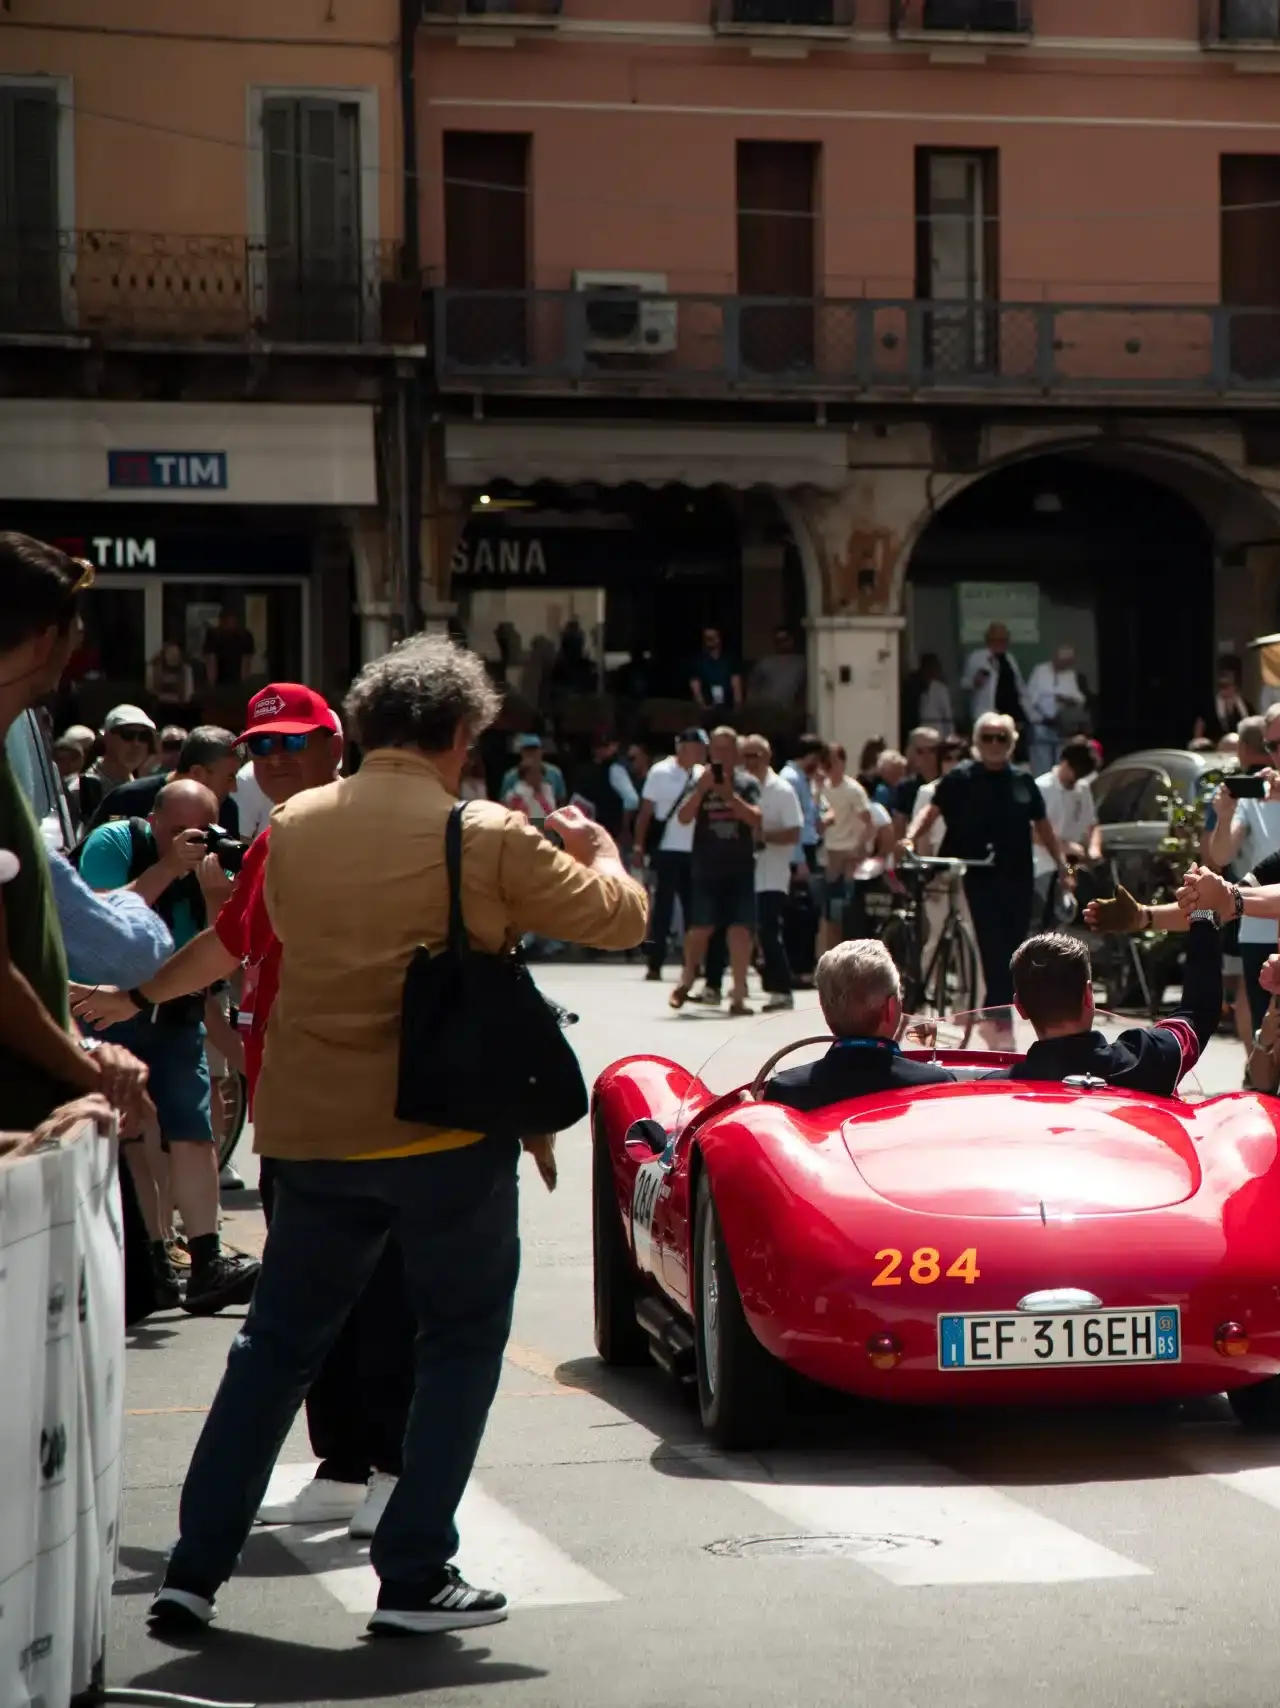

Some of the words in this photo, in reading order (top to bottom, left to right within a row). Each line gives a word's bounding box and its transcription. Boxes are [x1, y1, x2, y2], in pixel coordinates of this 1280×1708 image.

[155, 455, 219, 486] TIM
[91, 535, 157, 568] TIM
[633, 1168, 659, 1230] 284
[871, 1247, 981, 1287] 284
[971, 1320, 1015, 1360] EF
[1033, 1315, 1152, 1359] 316EH
[1157, 1335, 1174, 1355] BS
